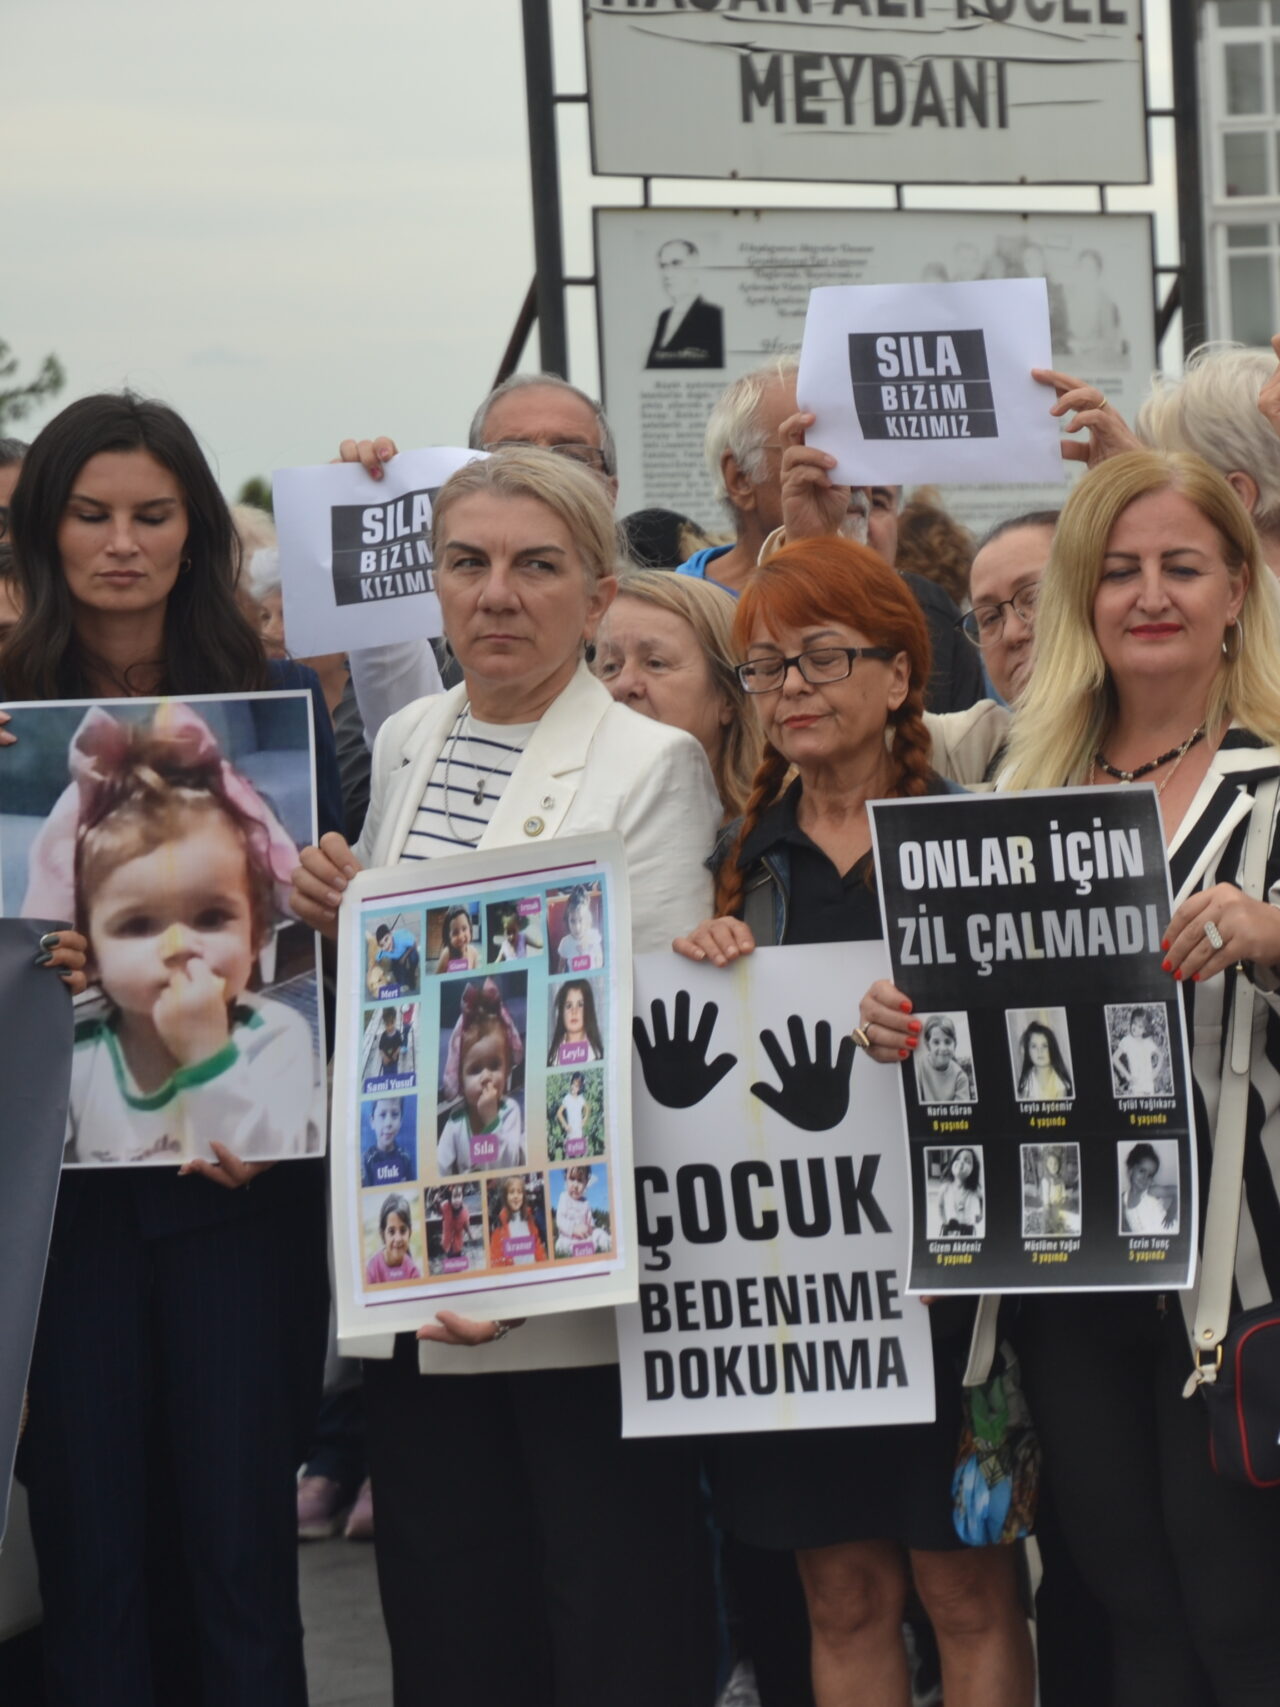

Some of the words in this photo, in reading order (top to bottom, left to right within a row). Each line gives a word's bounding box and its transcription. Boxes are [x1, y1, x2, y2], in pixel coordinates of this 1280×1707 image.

[739, 53, 1010, 129] MEYDANI
[876, 335, 962, 378] SILA
[885, 415, 971, 438] KIZIMIZ
[362, 493, 433, 544] SILA
[360, 568, 435, 600] KIZIMI
[898, 835, 1036, 891] ONLAR
[1049, 817, 1145, 895] İÇİN
[897, 903, 957, 966] ZİL
[966, 903, 1161, 977] ÇALMADI
[380, 988, 399, 1000] Mert
[562, 1047, 586, 1061] Leyla
[367, 1079, 389, 1093] Sami
[389, 1075, 414, 1090] Yusuf
[1020, 1102, 1040, 1114] Leyla
[1041, 1100, 1073, 1114] Aydemir
[474, 1140, 494, 1156] Sıla
[377, 1165, 400, 1180] Ufuk
[634, 1153, 893, 1272] ÇOCUK
[643, 1335, 909, 1402] DOKUNMA
